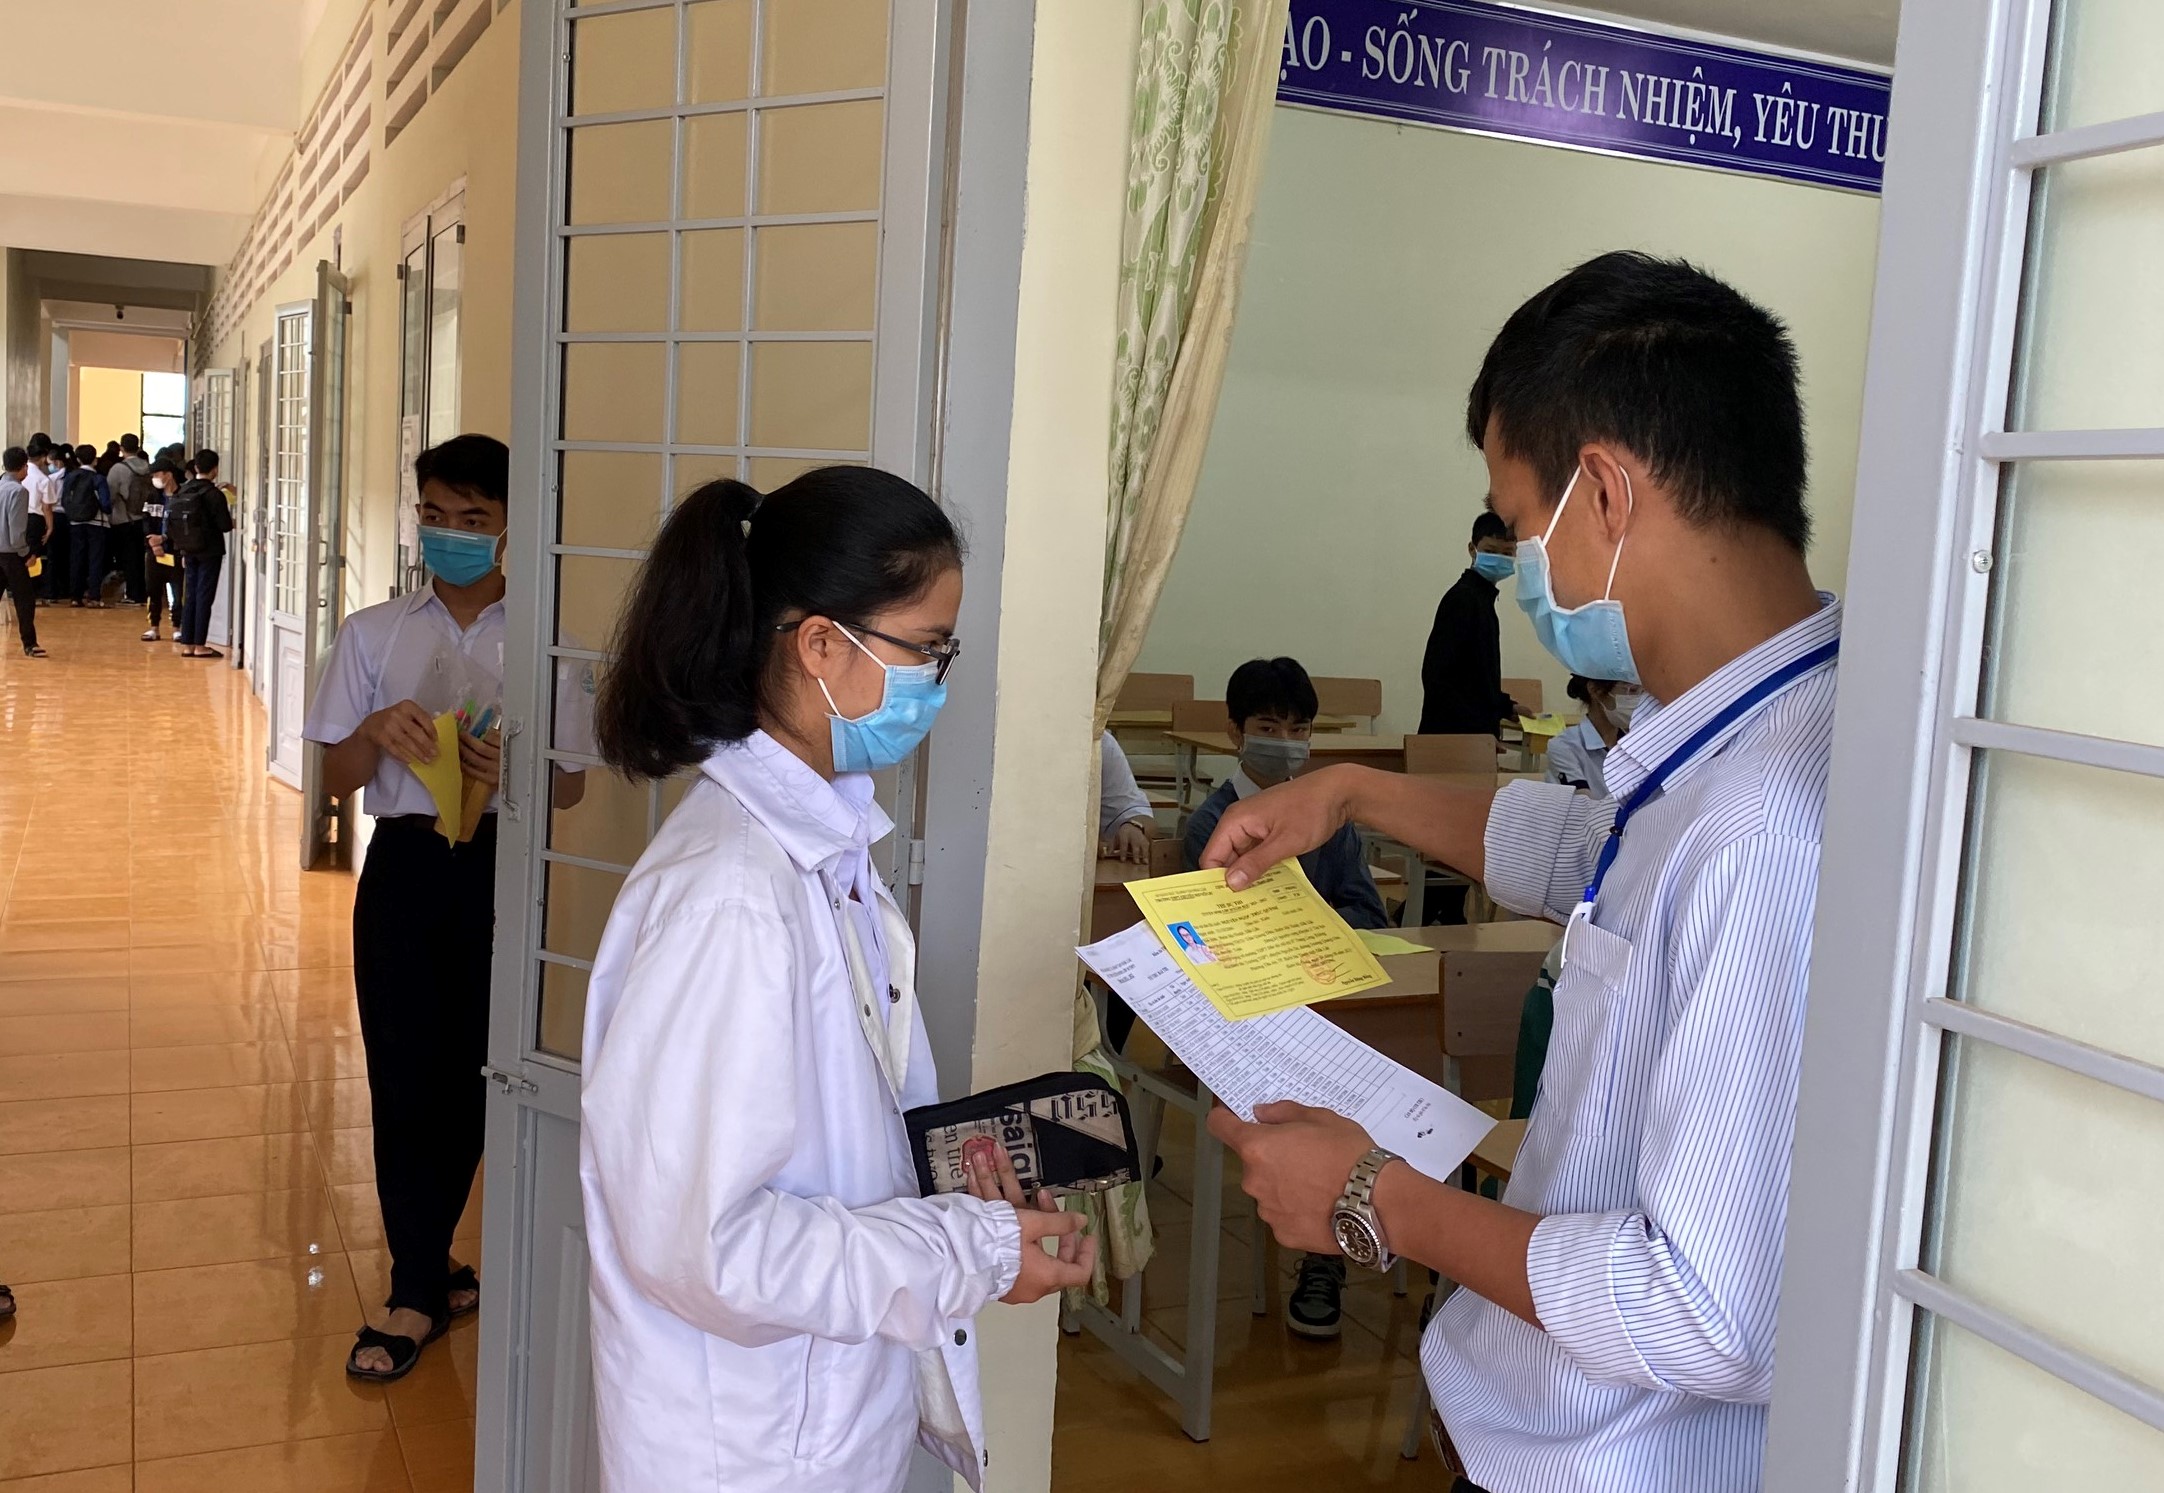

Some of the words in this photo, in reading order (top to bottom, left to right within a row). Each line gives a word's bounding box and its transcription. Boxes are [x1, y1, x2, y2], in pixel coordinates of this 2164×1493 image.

[1361, 7, 1472, 96] SỐNG
[1481, 39, 1611, 117] TRÁCH
[1615, 65, 1742, 150] NHIỆM,
[1752, 81, 1821, 150] YÊU
